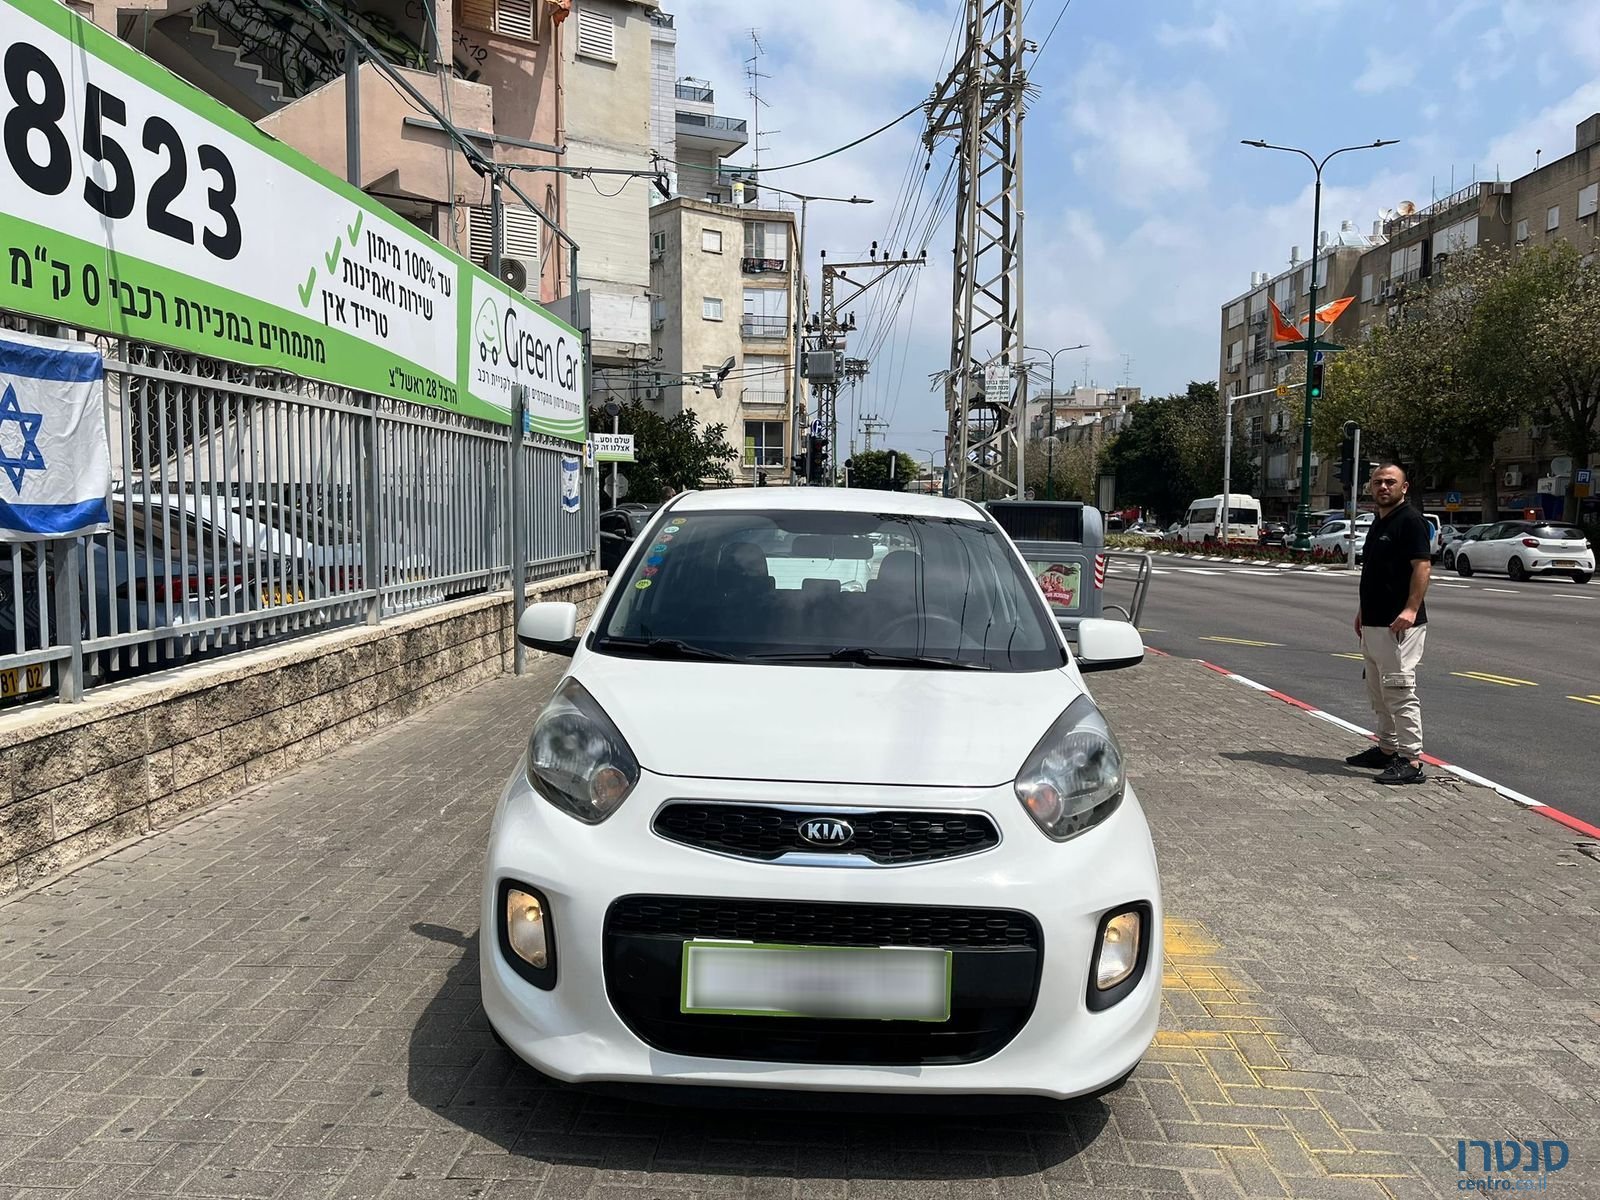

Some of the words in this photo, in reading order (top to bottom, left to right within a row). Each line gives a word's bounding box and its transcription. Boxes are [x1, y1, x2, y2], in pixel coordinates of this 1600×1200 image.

[3, 41, 242, 261] 8523
[367, 230, 401, 270] מימון
[82, 263, 100, 307] 0
[342, 257, 395, 305] ואמינות
[404, 249, 436, 290] 100%
[437, 271, 451, 297] עד
[109, 279, 167, 324] רכבי
[322, 289, 347, 326] אין
[350, 301, 388, 338] טרייד
[399, 284, 433, 321] שירות
[174, 296, 253, 345] במכירת
[259, 320, 326, 364] מתמחים
[504, 307, 554, 383] Green
[556, 336, 578, 392] Car
[426, 377, 437, 399] 28
[438, 380, 458, 405] הרצל
[478, 368, 490, 384] רכב
[610, 444, 630, 452] אצלנו
[614, 436, 630, 444] שלם
[807, 823, 845, 840] KIA
